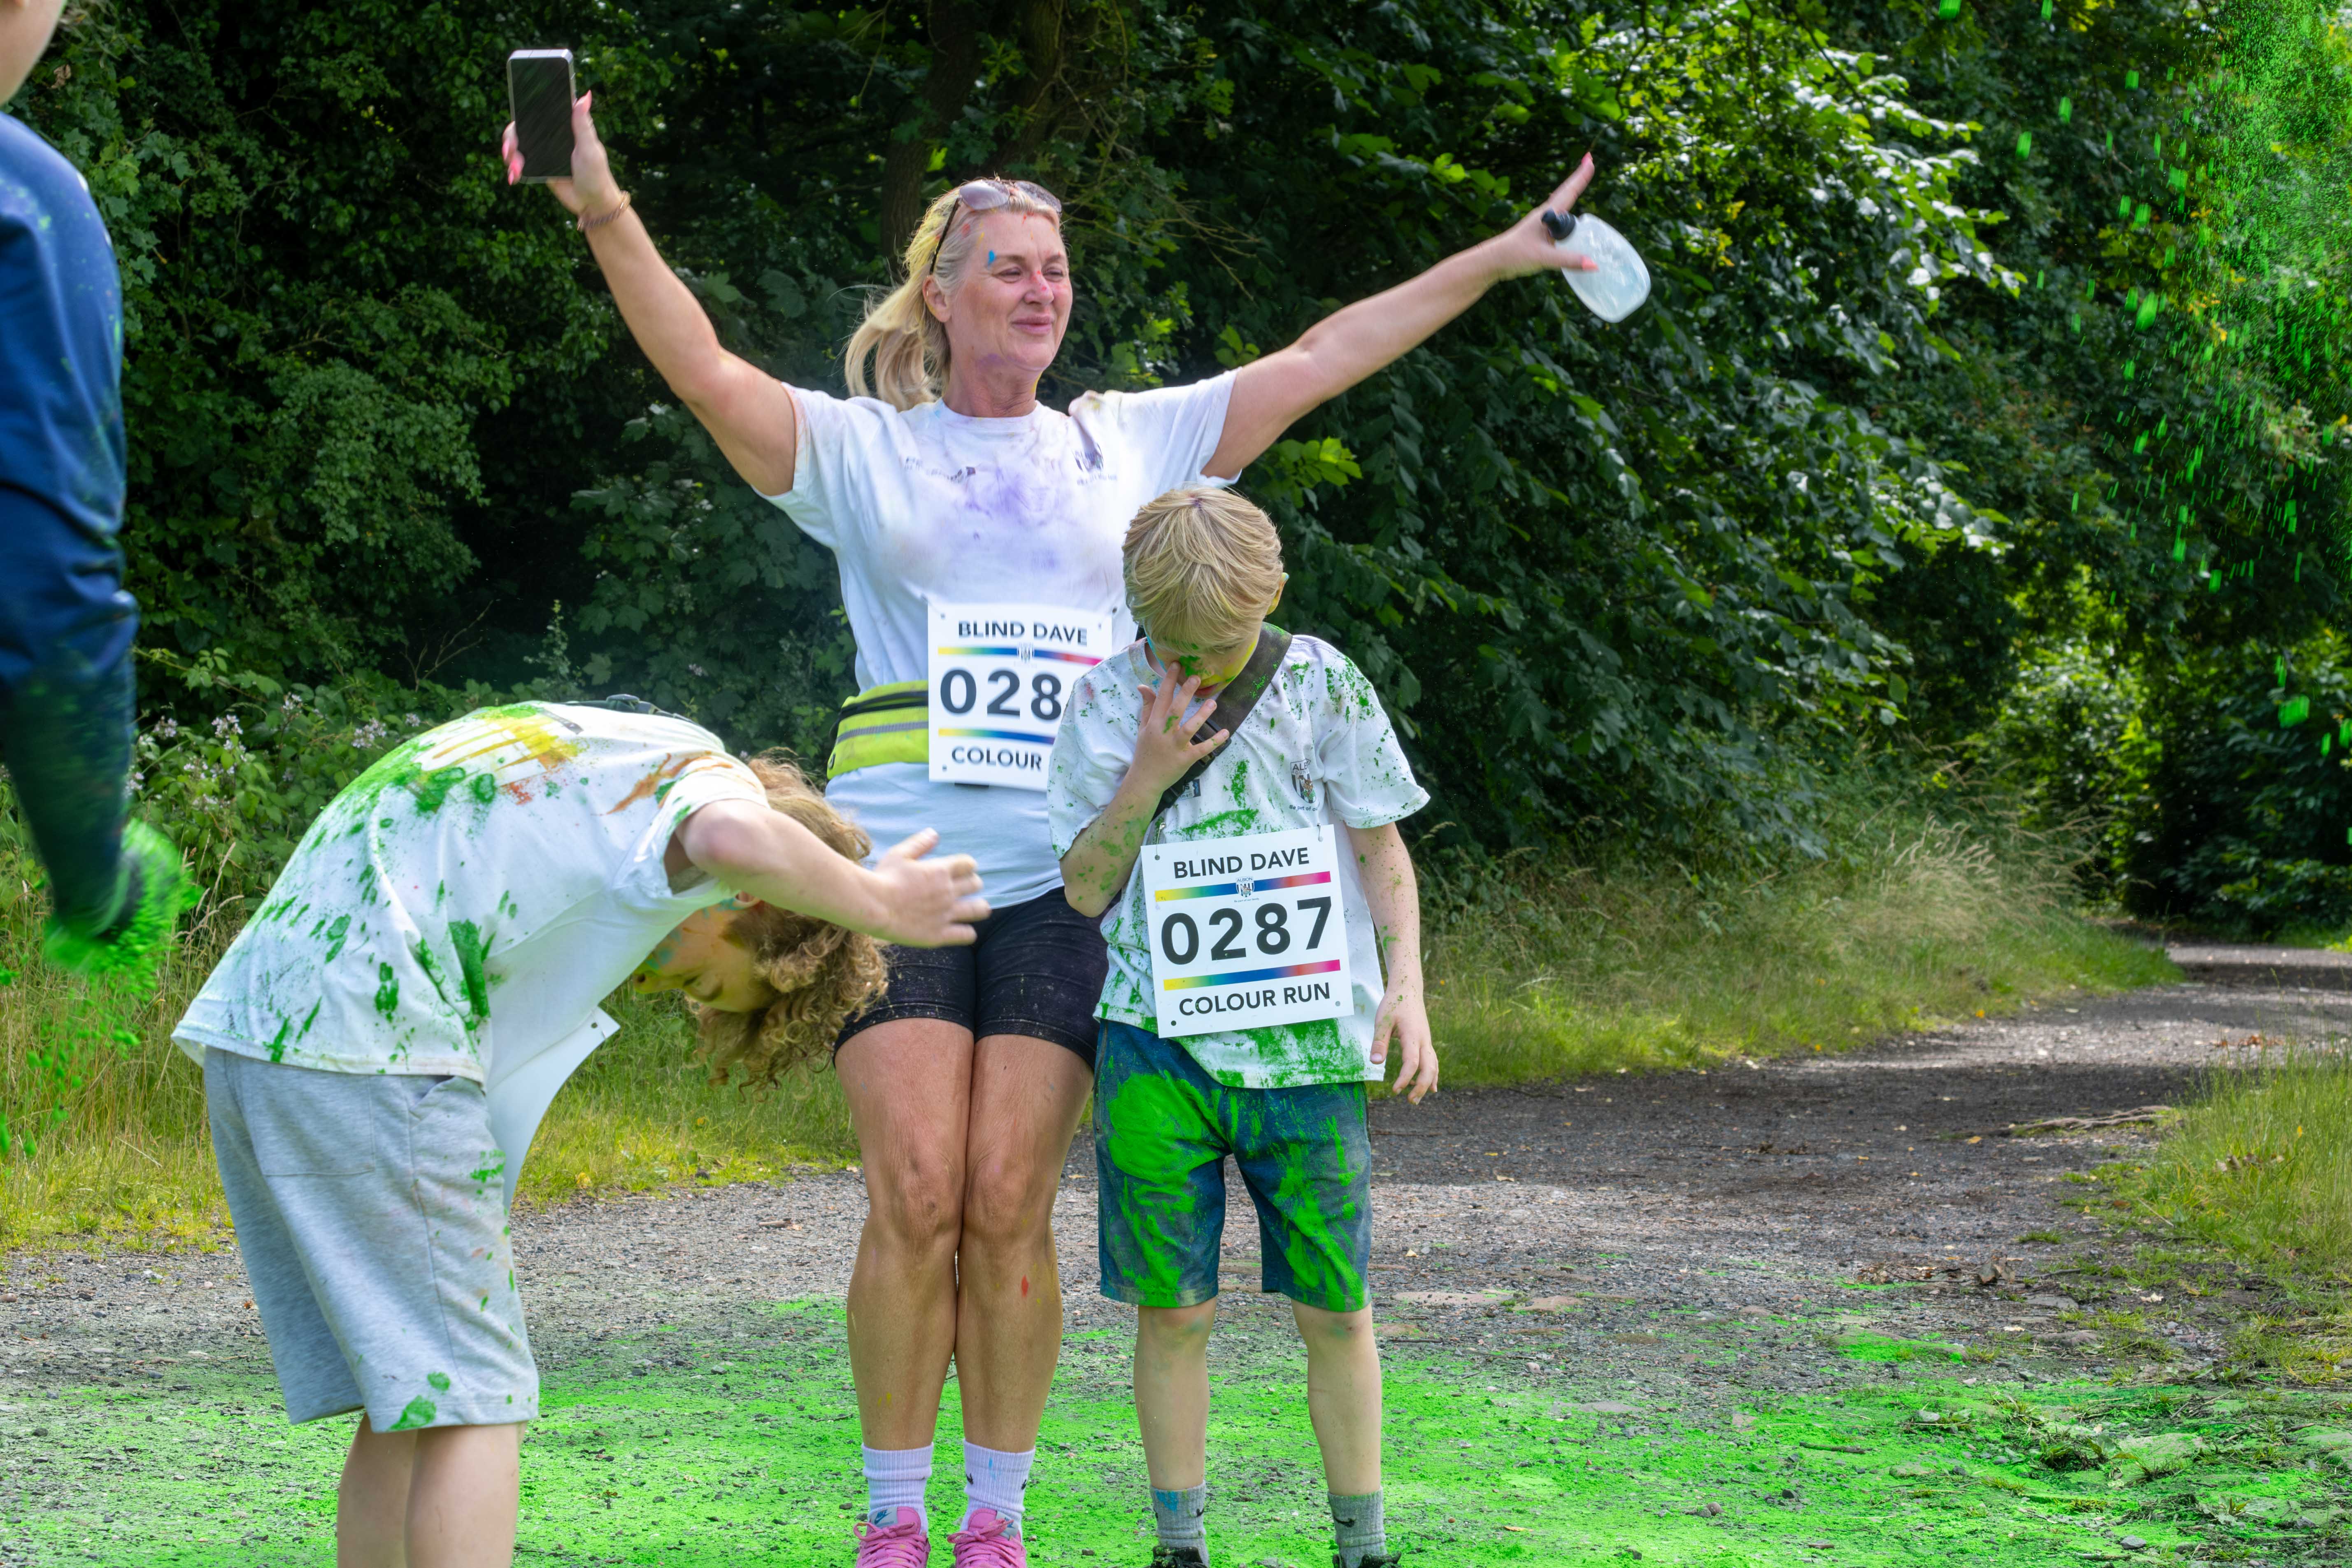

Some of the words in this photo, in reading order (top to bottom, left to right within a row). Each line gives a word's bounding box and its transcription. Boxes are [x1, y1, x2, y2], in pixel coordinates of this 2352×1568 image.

[958, 620, 1025, 638] BLIND
[1033, 622, 1087, 647] DAVE
[940, 668, 1061, 721] 028
[952, 747, 1042, 770] COLOUR
[1174, 856, 1242, 879] BLIND
[1251, 847, 1310, 870] DAVE
[1161, 896, 1331, 965] 0287
[1179, 989, 1276, 1016] COLOUR
[1284, 982, 1330, 1005] RUN
